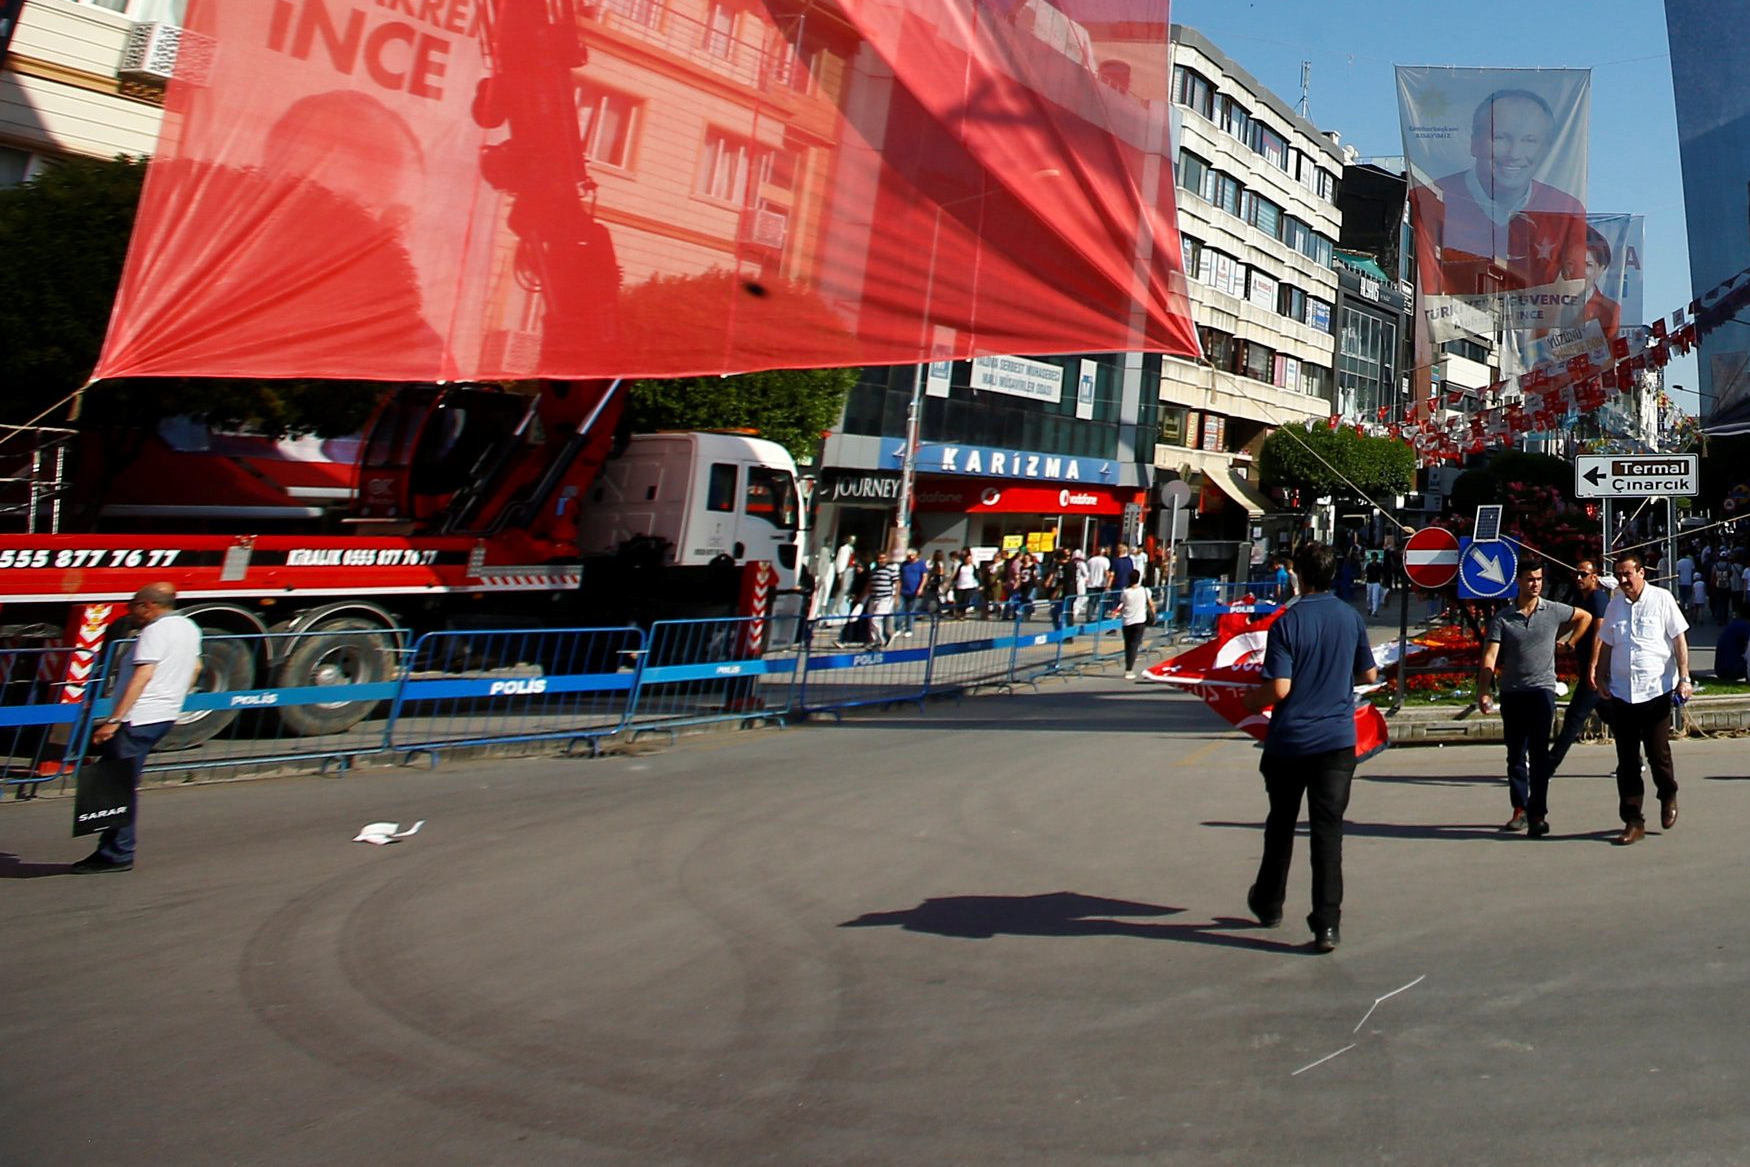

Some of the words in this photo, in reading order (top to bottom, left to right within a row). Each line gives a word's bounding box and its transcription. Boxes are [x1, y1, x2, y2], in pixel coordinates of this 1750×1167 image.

[1620, 462, 1685, 474] Termal
[832, 476, 901, 501] JOURNEY
[1612, 478, 1689, 493] Çınarcık
[54, 549, 108, 568] 877
[109, 549, 144, 568] 76
[146, 549, 182, 567] 77
[376, 549, 405, 566] 877
[402, 549, 421, 565] 76
[490, 676, 547, 696] POLİS
[78, 806, 128, 822] SARAR
